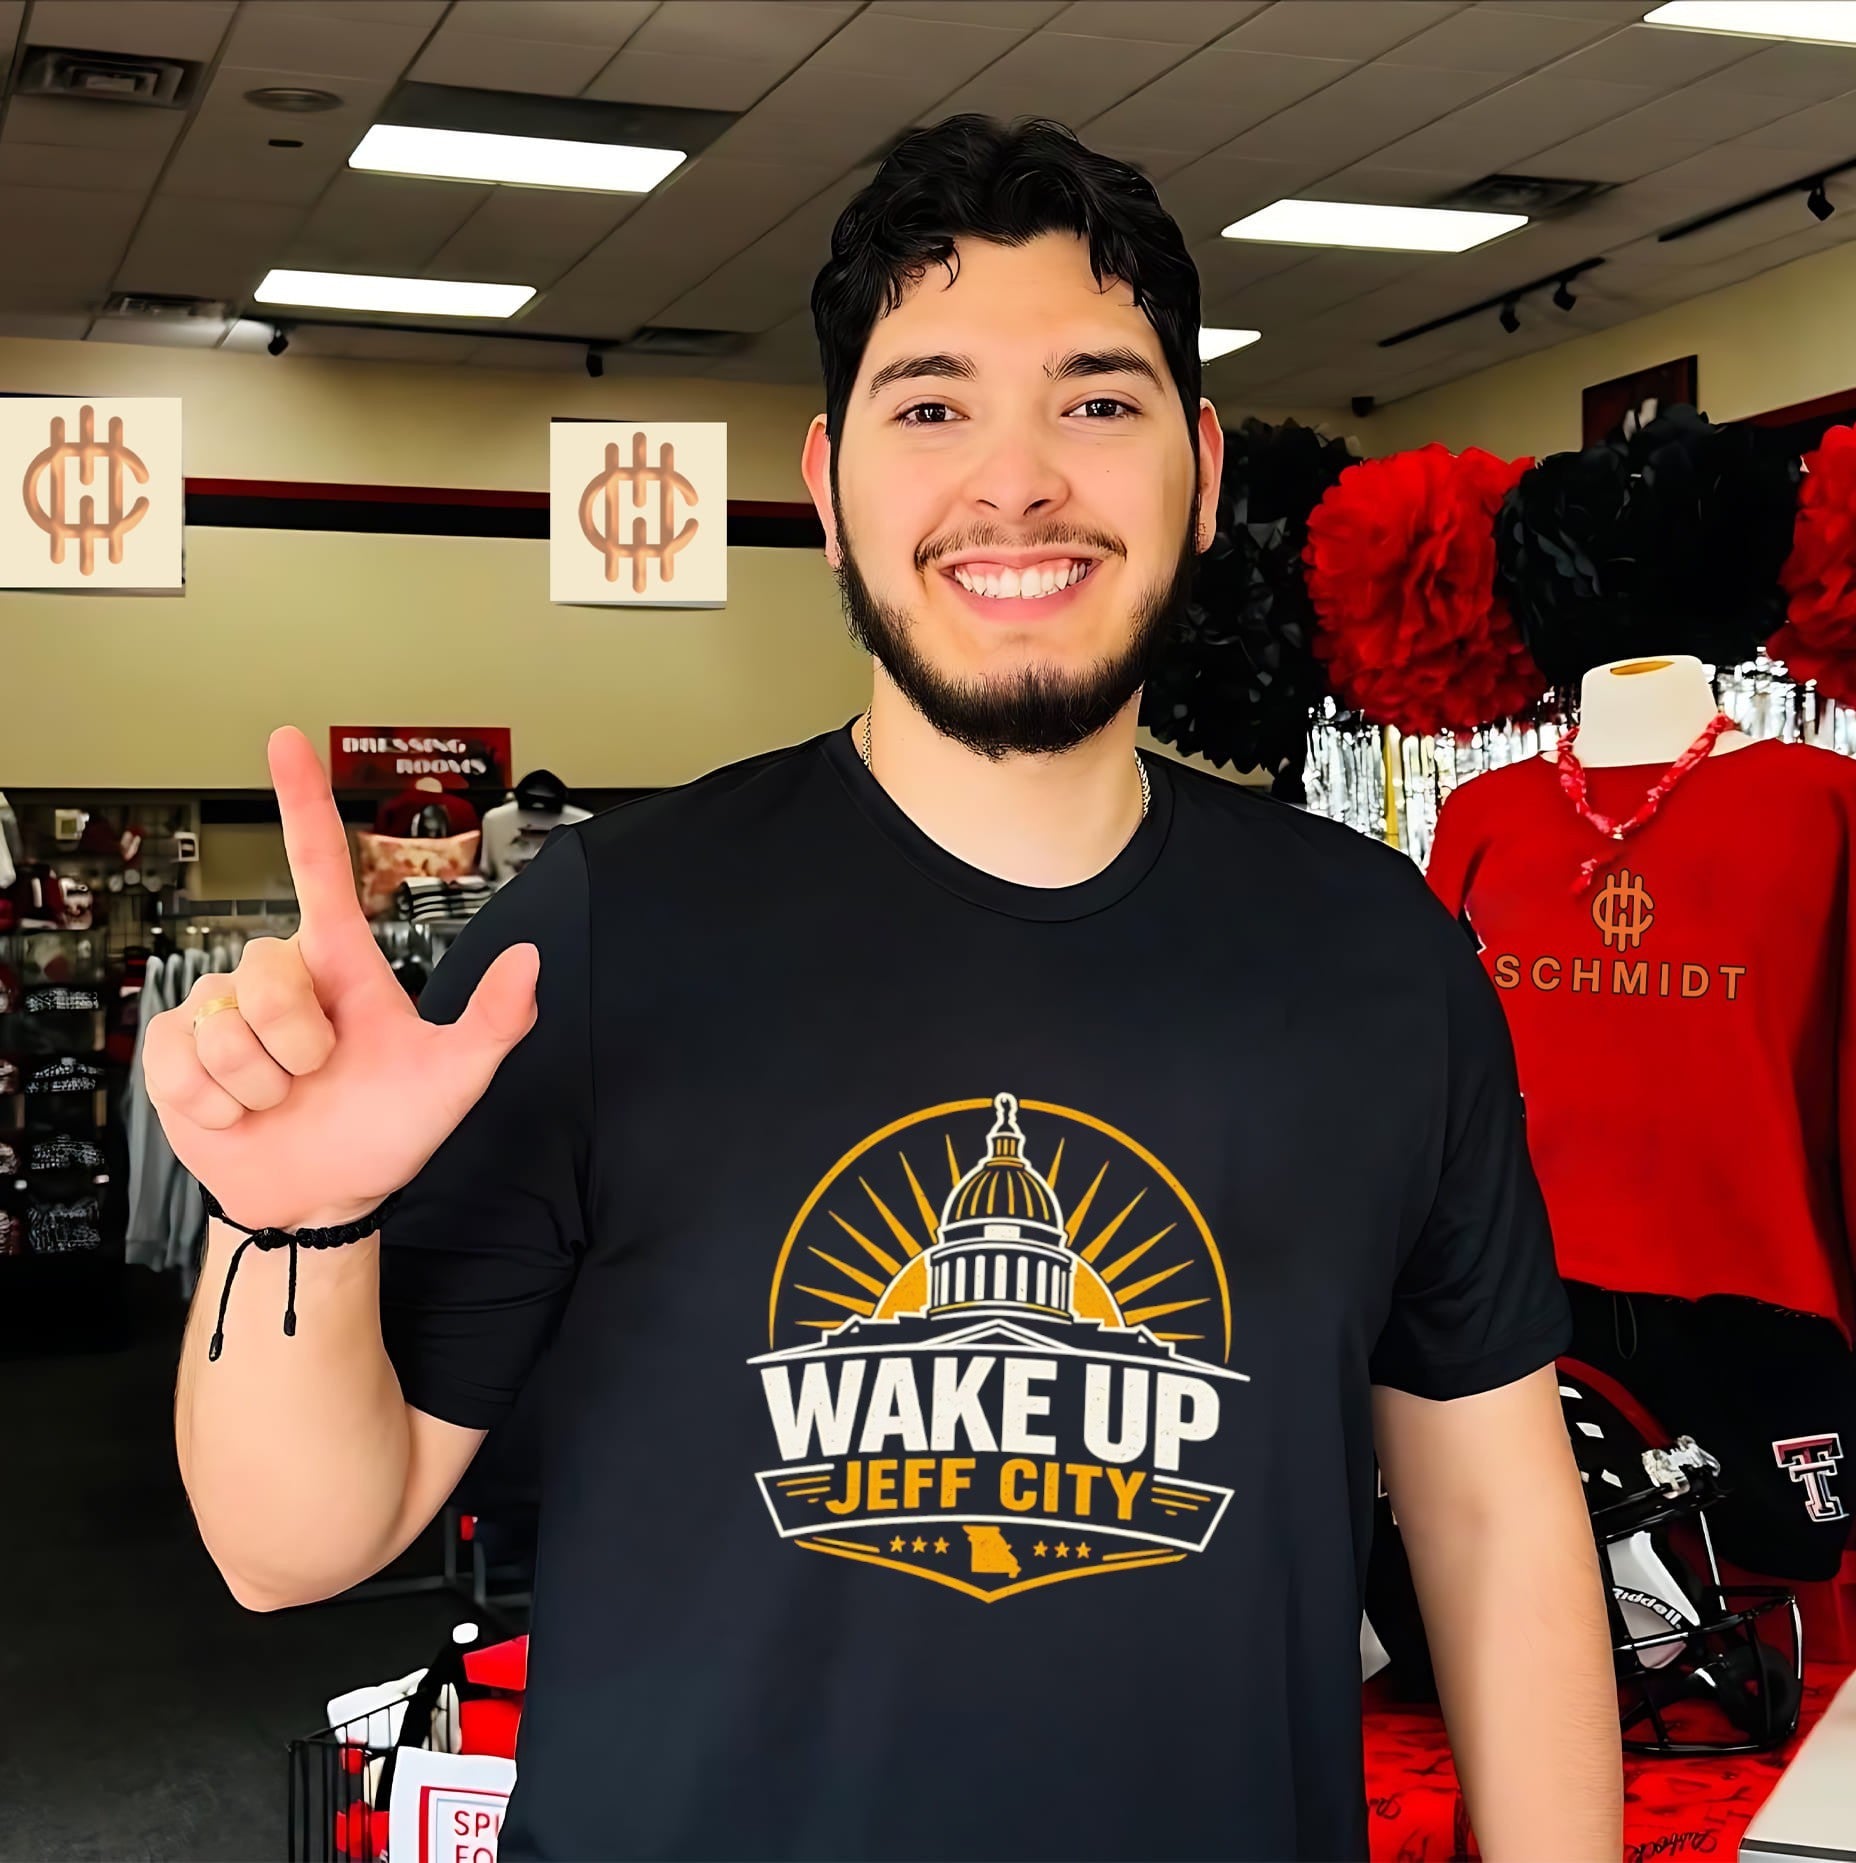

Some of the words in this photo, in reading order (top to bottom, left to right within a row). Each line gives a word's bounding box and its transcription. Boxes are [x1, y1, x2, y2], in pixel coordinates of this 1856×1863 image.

[1494, 954, 1747, 1000] SCHMIDT
[761, 1355, 1058, 1461] WAKE
[1083, 1362, 1220, 1472] UP
[825, 1457, 976, 1516] JEFF
[999, 1457, 1147, 1521] CITY
